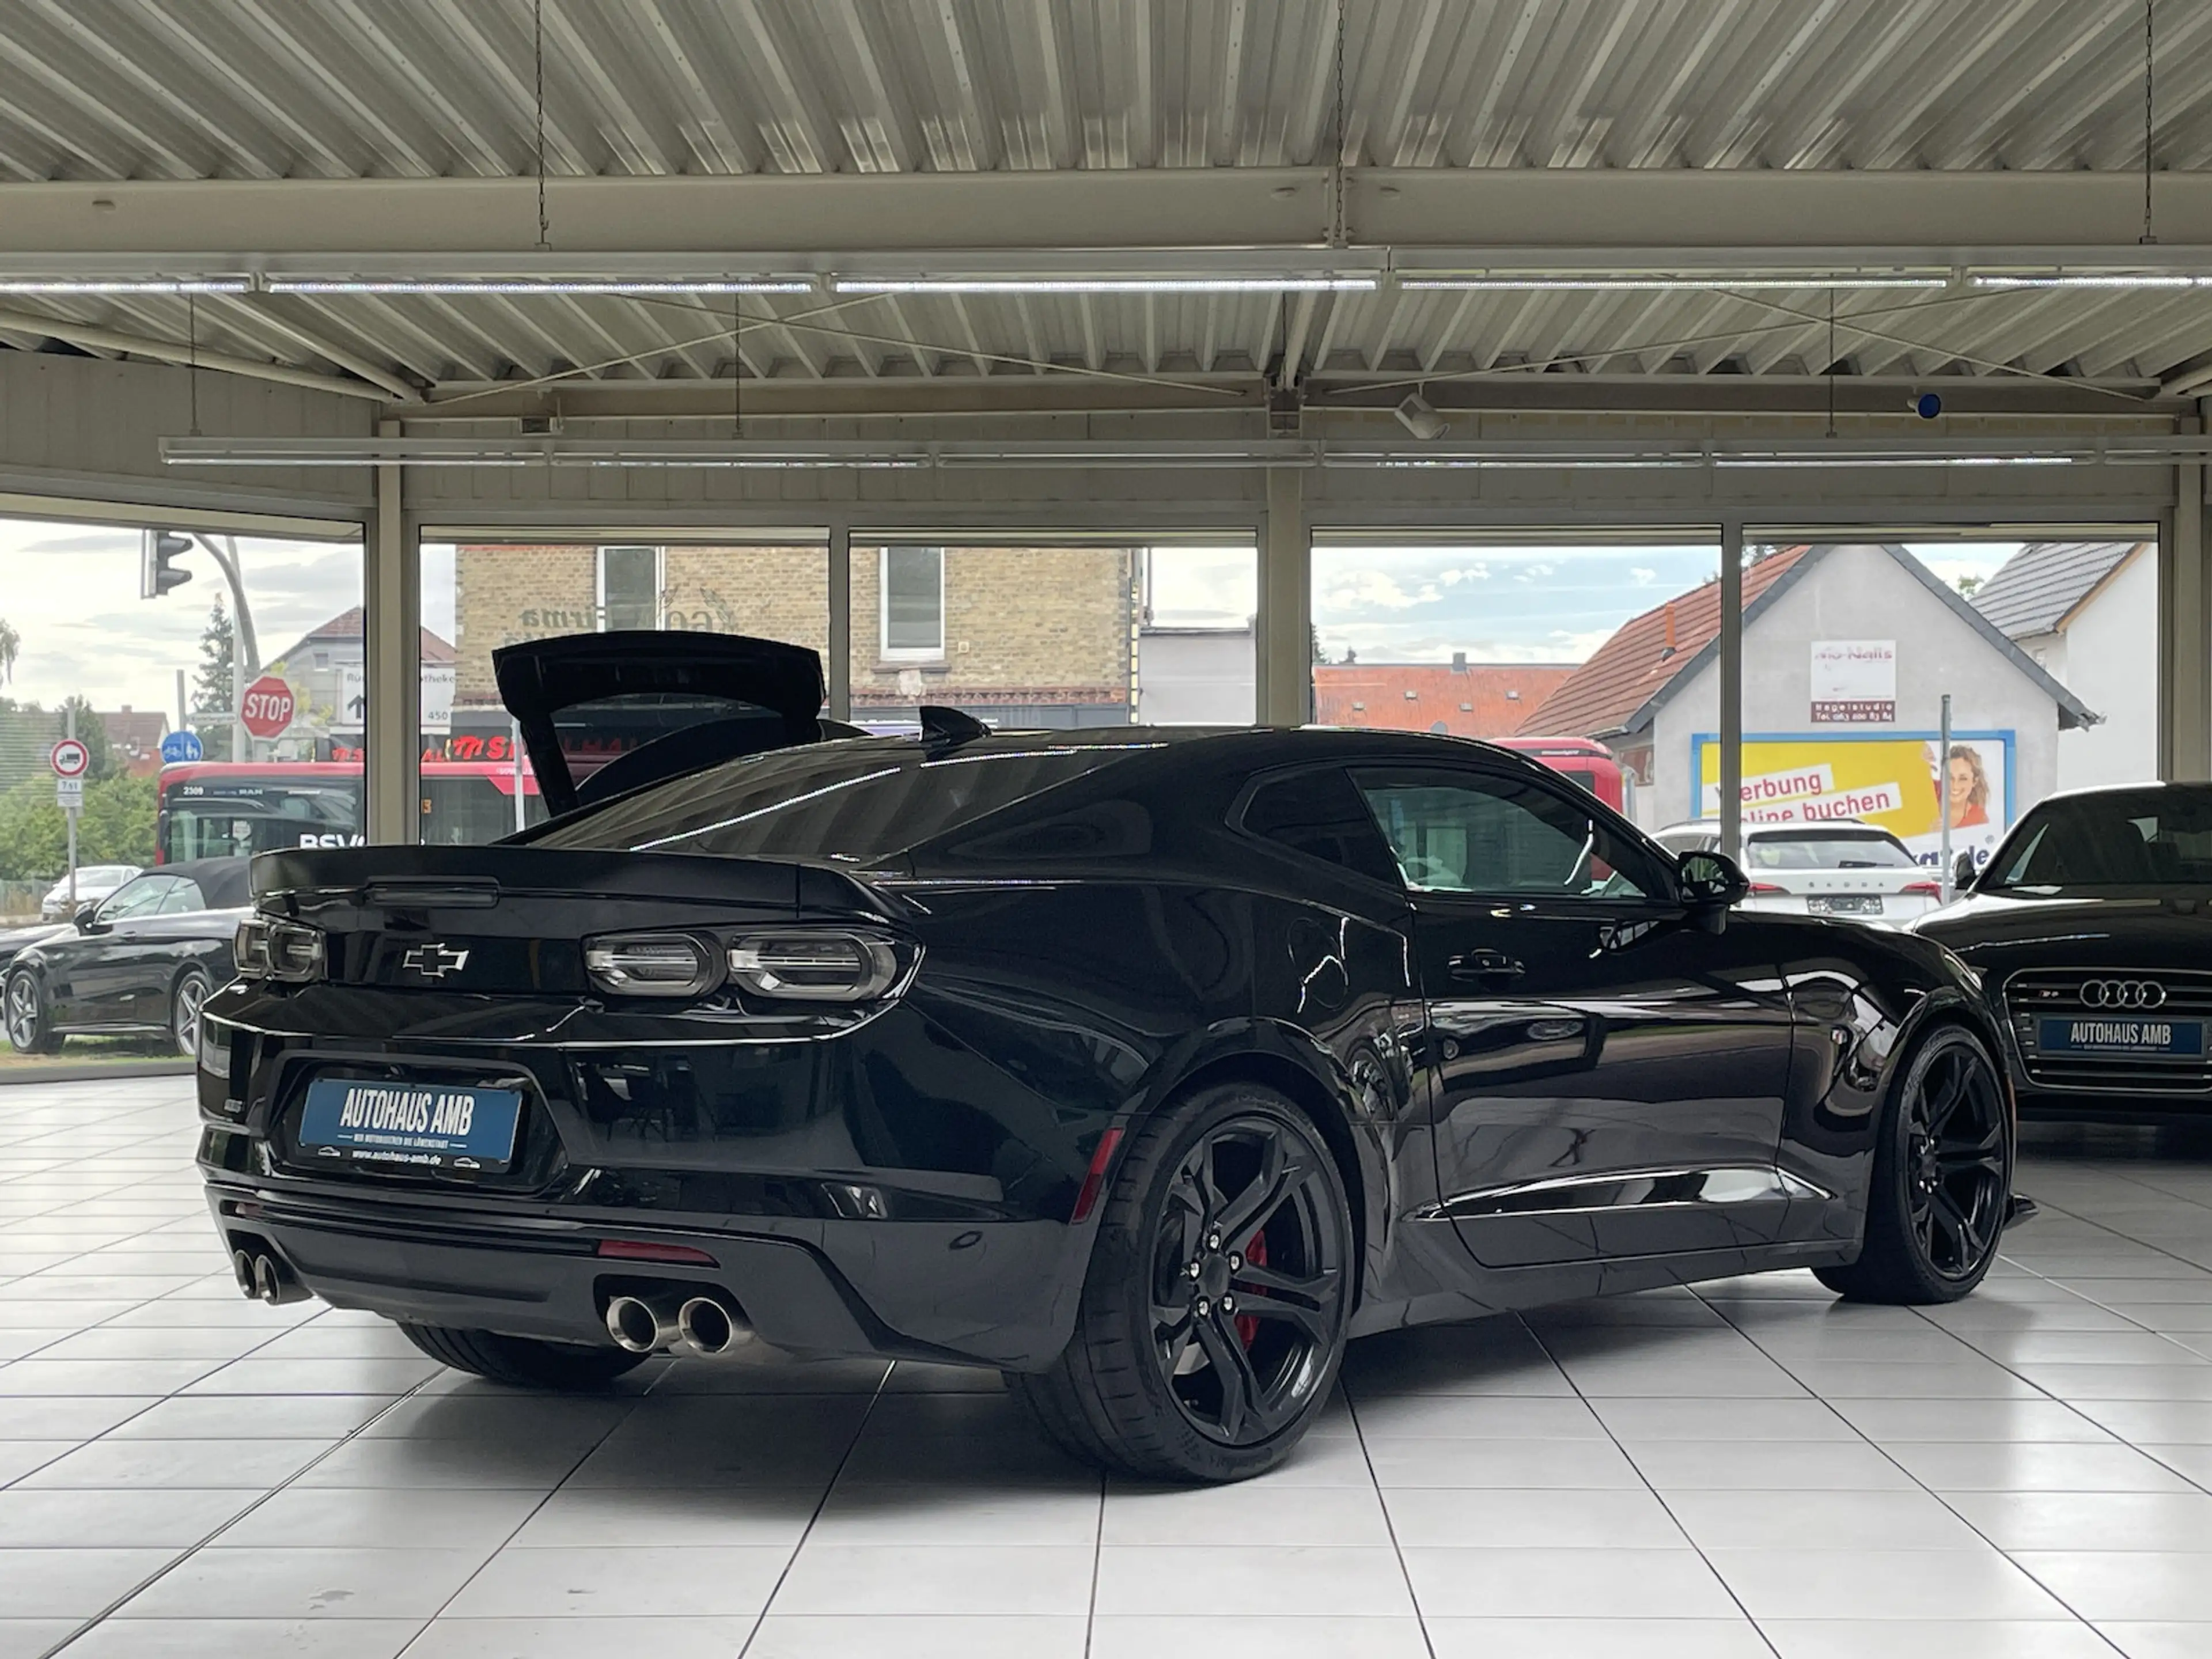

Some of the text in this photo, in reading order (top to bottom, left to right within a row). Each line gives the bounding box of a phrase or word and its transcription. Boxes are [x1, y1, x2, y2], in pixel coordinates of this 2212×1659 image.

[245, 693, 291, 722] STOP
[1715, 774, 1822, 801] erbung
[1802, 793, 1890, 821] buchen
[2071, 1022, 2172, 1045] AUTOHAUS AMB
[340, 1088, 475, 1136] AUTOHAUS AMB
